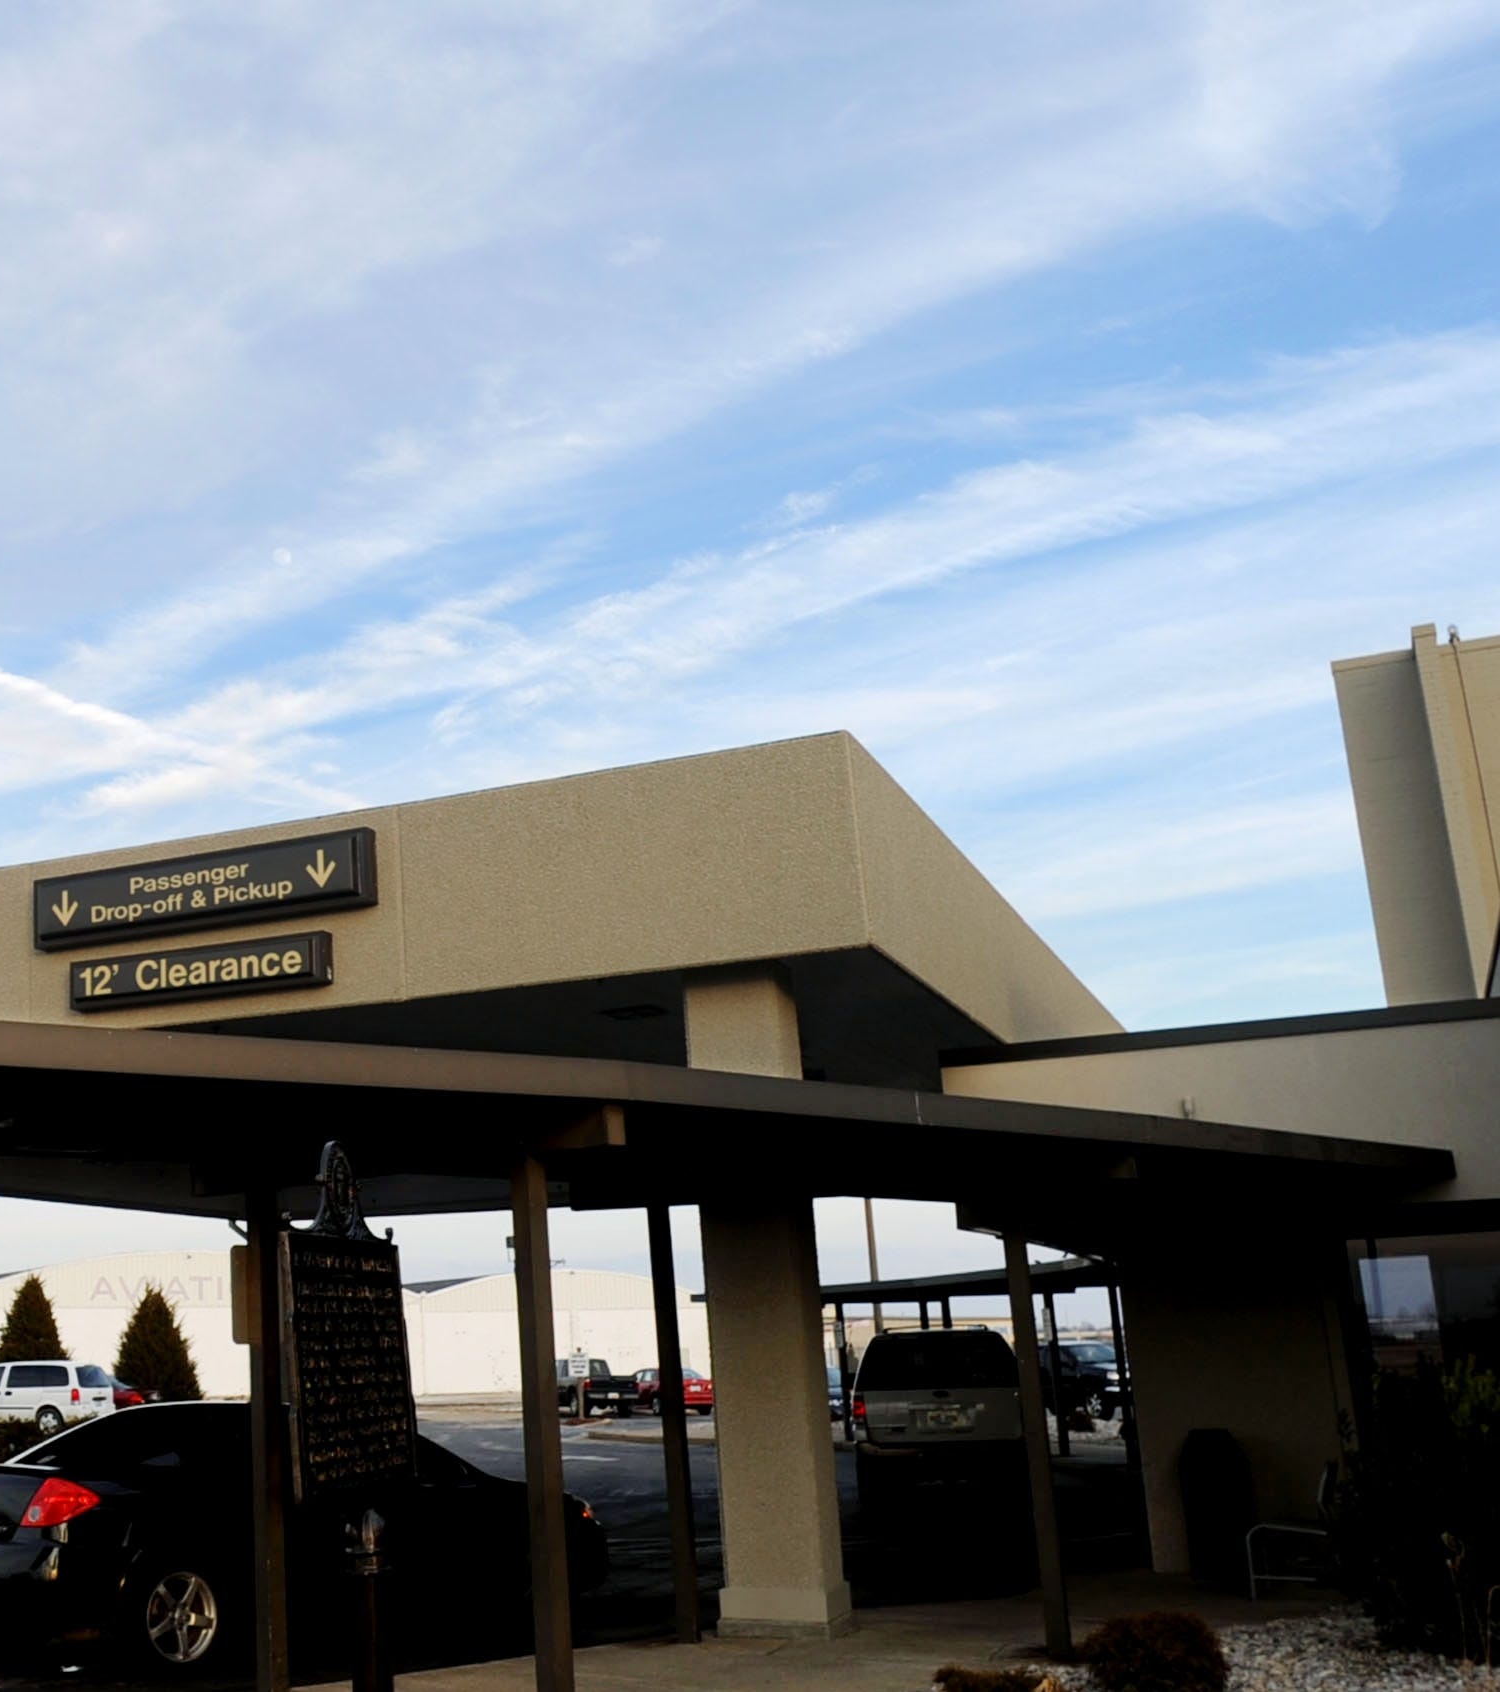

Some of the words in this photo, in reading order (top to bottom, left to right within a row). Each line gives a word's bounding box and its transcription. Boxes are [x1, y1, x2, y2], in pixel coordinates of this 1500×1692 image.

[129, 863, 249, 895] Passenger
[90, 891, 184, 924] Drop-off
[190, 891, 207, 908] &
[214, 878, 293, 905] Pickup
[79, 963, 119, 997] 12'
[135, 950, 303, 991] Clearance
[90, 1276, 223, 1301] AVATI
